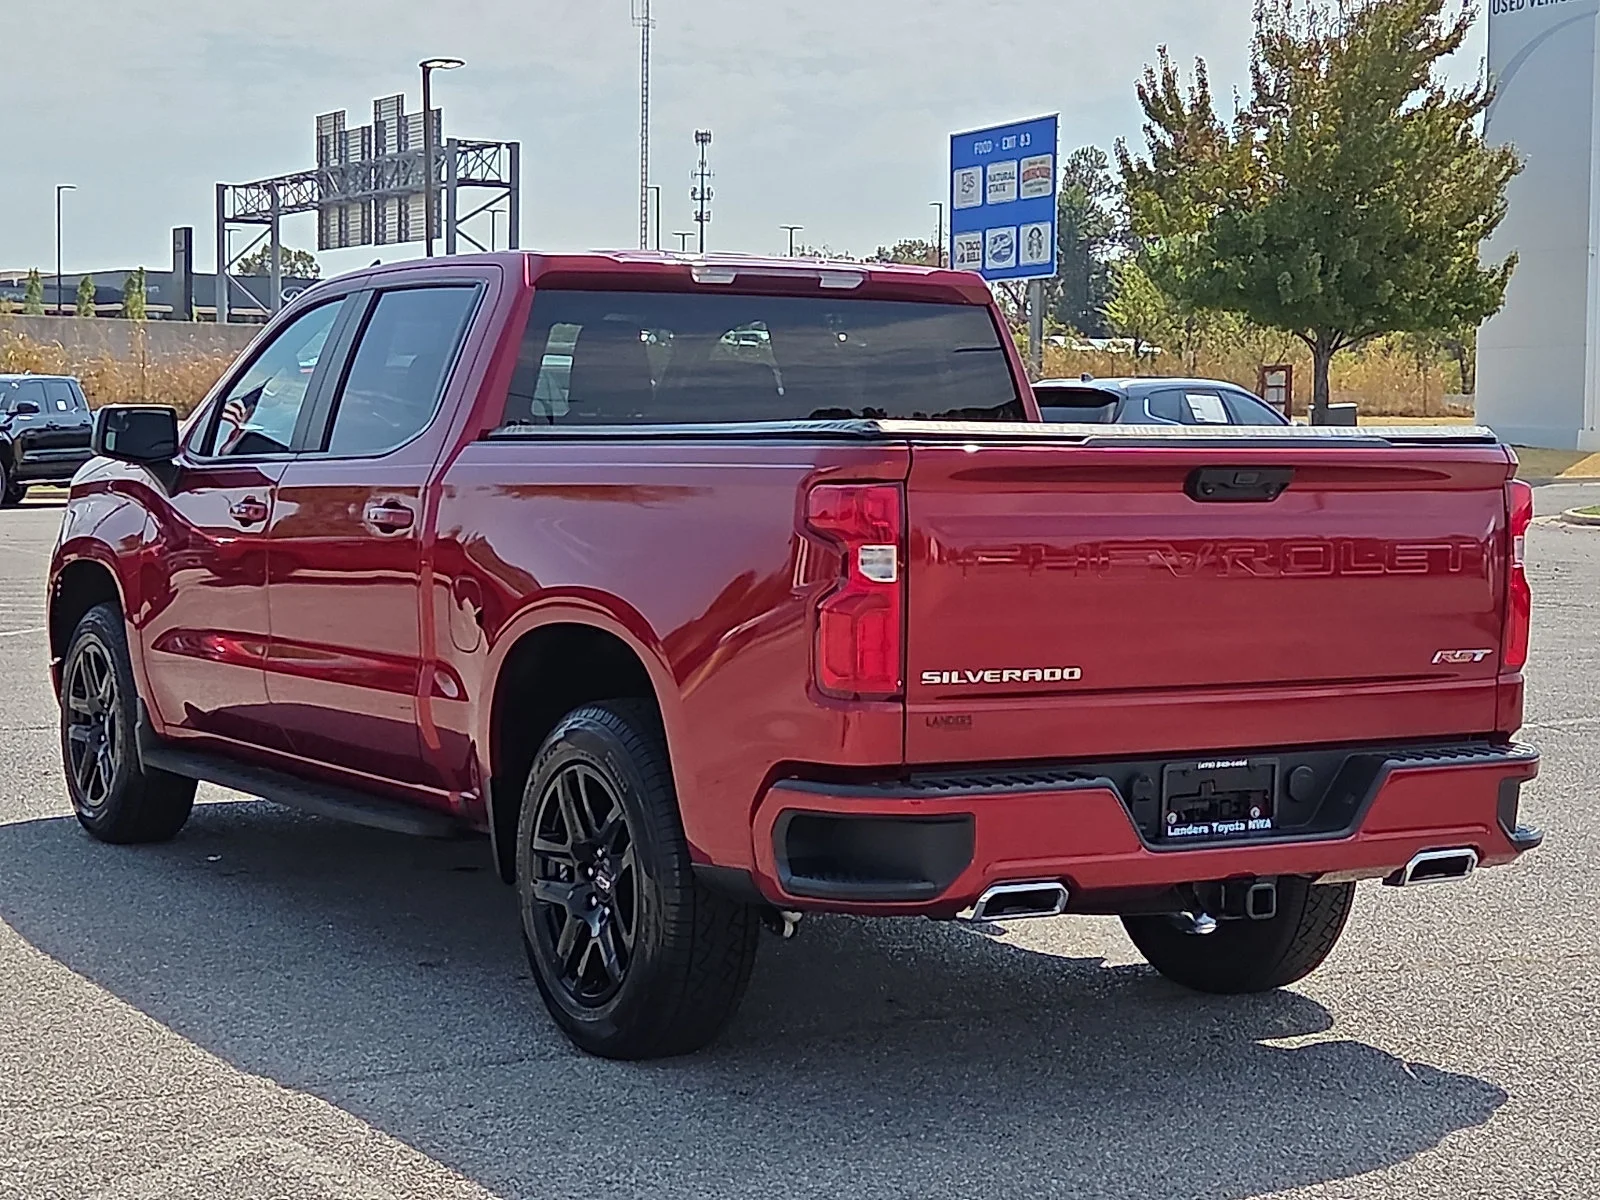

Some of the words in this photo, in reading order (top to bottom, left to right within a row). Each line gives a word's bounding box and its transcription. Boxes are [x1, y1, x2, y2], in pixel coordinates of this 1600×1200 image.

[1491, 0, 1525, 15] USED
[974, 141, 993, 155] FOOD
[1002, 135, 1017, 150] EXIT
[988, 171, 1016, 182] NATURAL
[988, 183, 1007, 193] STATE
[1431, 649, 1493, 664] RST
[921, 667, 1082, 684] SILVERADO
[925, 714, 971, 727] LANDERS
[1167, 824, 1209, 836] Landers
[1212, 822, 1246, 835] Toyota
[1248, 818, 1272, 830] NWA
